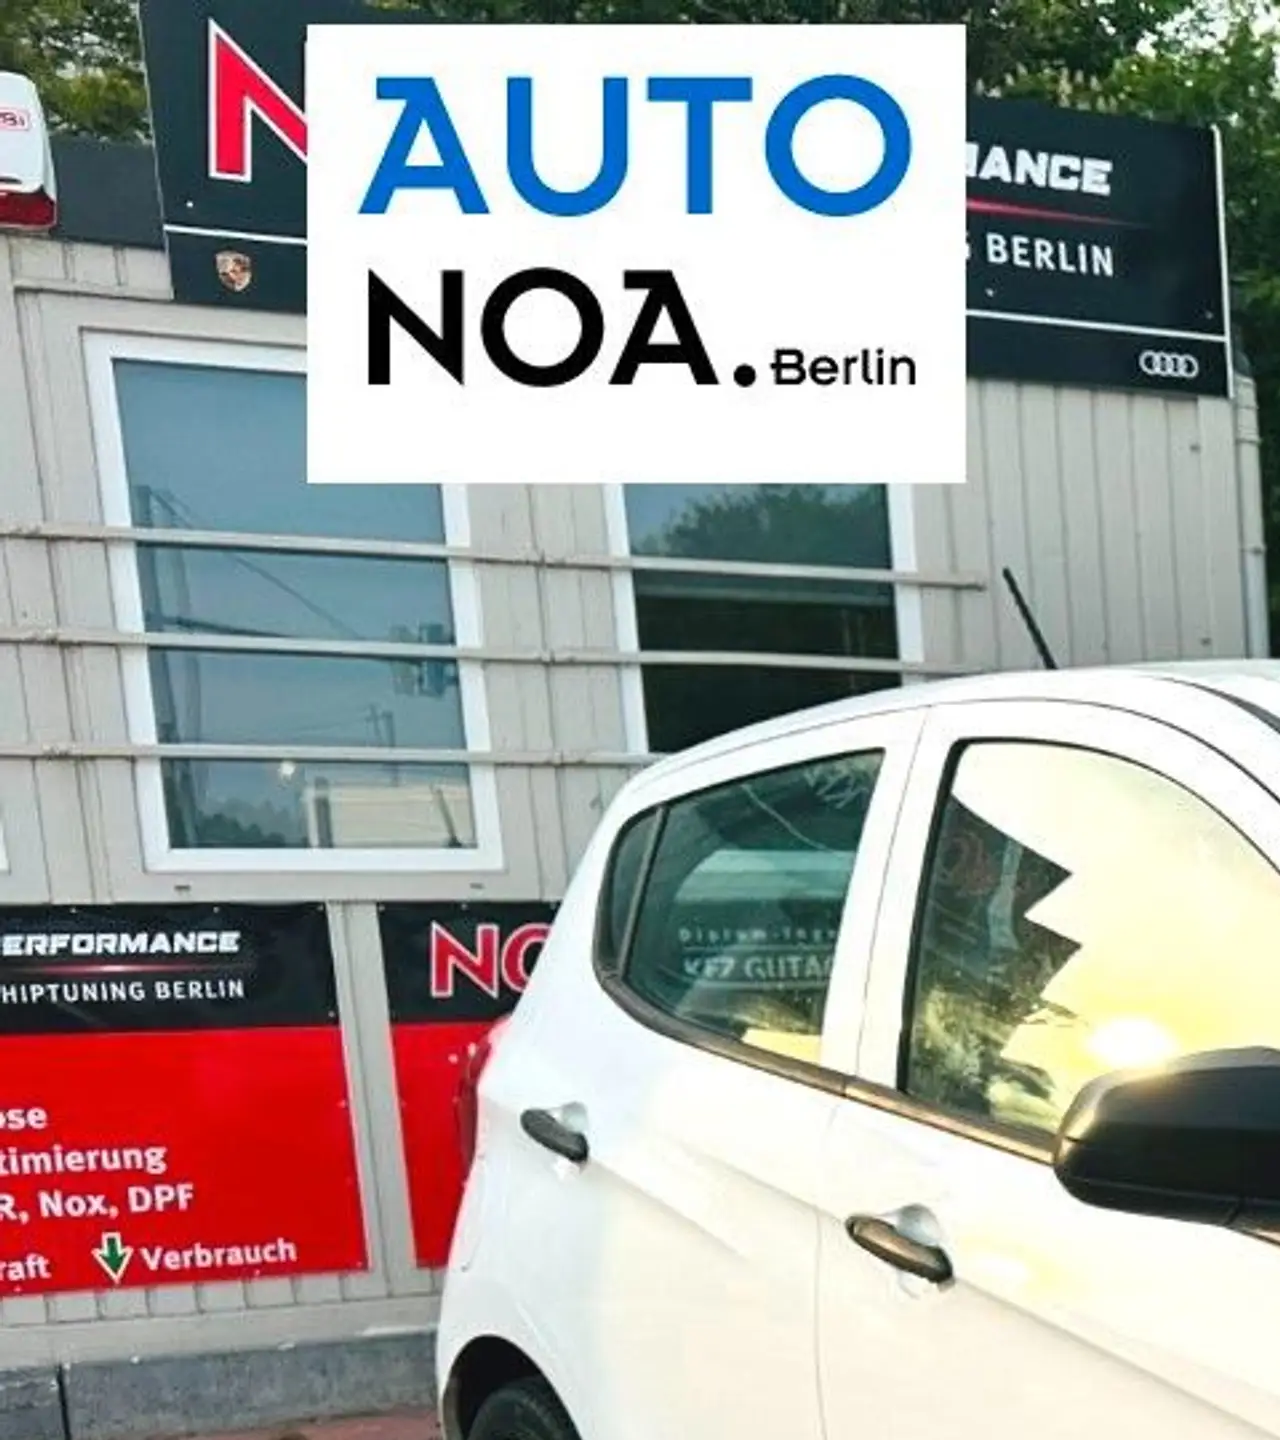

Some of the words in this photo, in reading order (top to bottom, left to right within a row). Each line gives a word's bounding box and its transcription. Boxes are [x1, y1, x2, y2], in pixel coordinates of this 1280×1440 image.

[986, 232, 1113, 277] BERLIN
[0, 931, 241, 956] ERFORMANCE
[0, 981, 146, 1004] HIPTUNING
[154, 979, 245, 999] BERLIN
[38, 1188, 120, 1220] Nox,
[127, 1182, 194, 1214] DPF
[139, 1236, 298, 1271] Verbrauch
